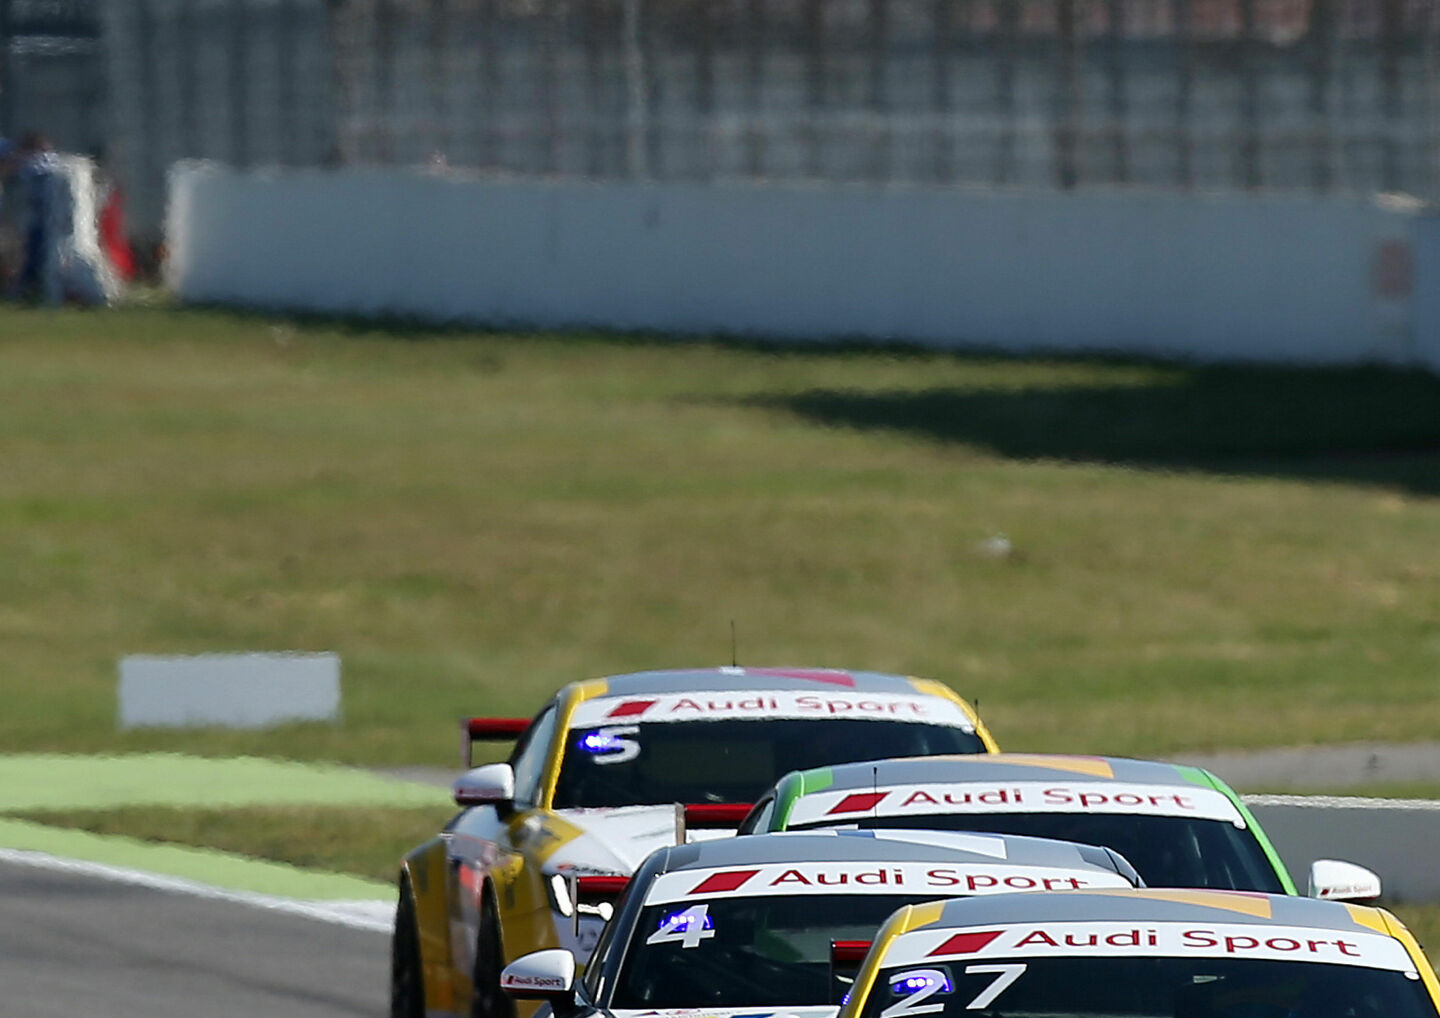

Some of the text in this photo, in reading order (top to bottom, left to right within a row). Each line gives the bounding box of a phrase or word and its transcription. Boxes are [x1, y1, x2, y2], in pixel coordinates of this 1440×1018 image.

[671, 697, 928, 717] Audi Sport
[593, 726, 641, 765] 5
[900, 787, 1196, 812] Audi Sport
[769, 869, 1089, 892] Audi Sport
[646, 904, 716, 949] 4
[1013, 929, 1362, 957] Audi Sport
[533, 975, 561, 988] Sport
